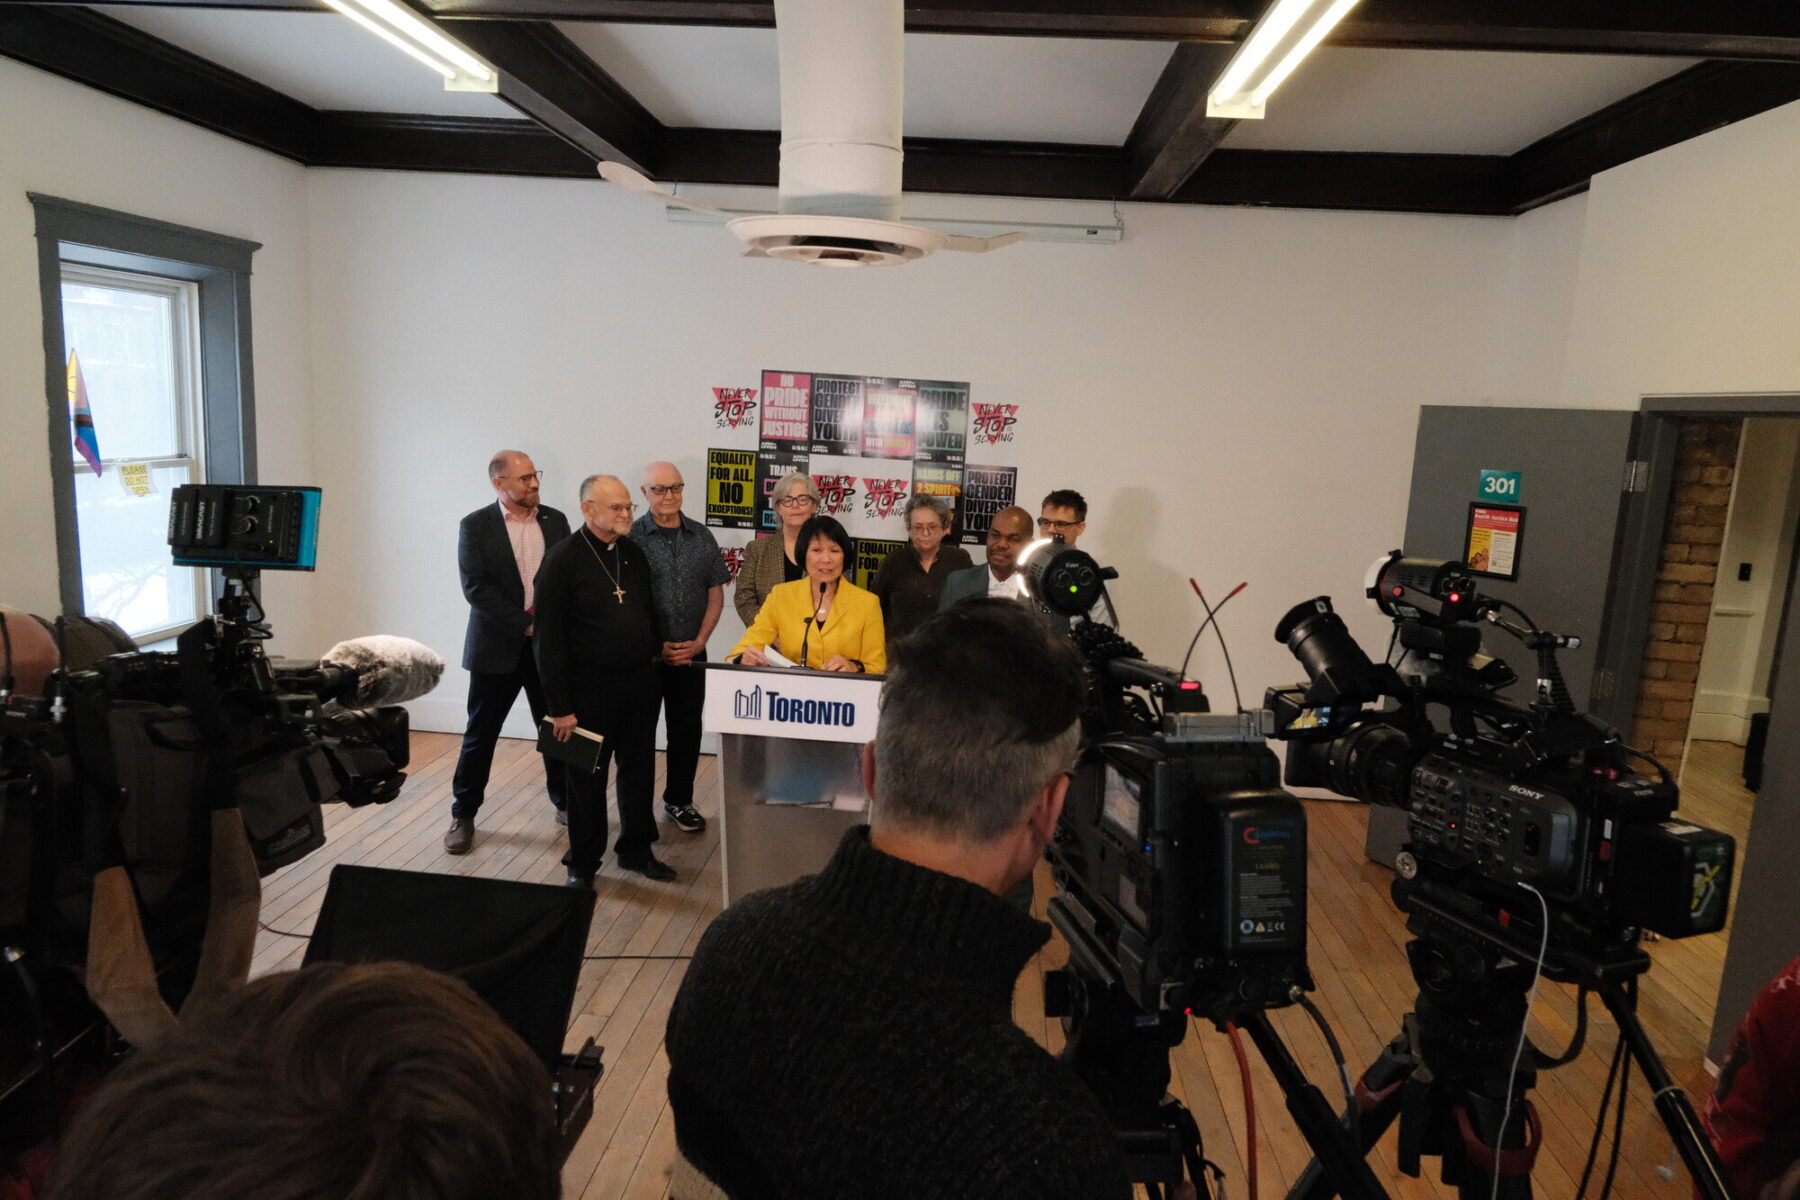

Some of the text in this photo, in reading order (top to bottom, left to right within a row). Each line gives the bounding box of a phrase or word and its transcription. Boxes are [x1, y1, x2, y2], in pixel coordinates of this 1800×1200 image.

[780, 375, 794, 387] NO
[816, 379, 862, 395] PROTECT
[719, 387, 751, 400] NEVER
[764, 386, 809, 407] PRIDE
[920, 389, 966, 411] PRIDE
[815, 394, 857, 409] GEND
[714, 400, 757, 418] STOP
[764, 407, 808, 421] WITHOUT
[815, 408, 852, 422] DIVE
[978, 403, 1011, 416] NEVER
[716, 416, 754, 429] SERVING
[762, 420, 808, 438] JUSTICE
[973, 416, 1017, 434] STOP
[918, 432, 963, 450] POWER
[974, 432, 1014, 445] SERVING
[711, 452, 754, 466] EQUALITY
[121, 464, 147, 474] PLEASE
[710, 467, 753, 482] FOR ALL.
[916, 468, 961, 481] HANDS OFF
[818, 475, 850, 487] NEVER
[869, 477, 902, 491] NEVER
[967, 471, 1013, 486] PROTECT
[1484, 477, 1516, 494] 301
[719, 482, 744, 504] NO
[966, 484, 1012, 500] GENDER
[864, 490, 907, 509] STOP
[708, 504, 753, 516] EXCEPTIONS!
[866, 506, 904, 519] SERVING
[965, 513, 992, 530] YOU
[720, 547, 745, 558] EVER
[859, 542, 905, 555] EQUAL
[858, 557, 879, 570] FOR
[766, 691, 855, 727] TORONTO
[1509, 784, 1544, 799] SONY
